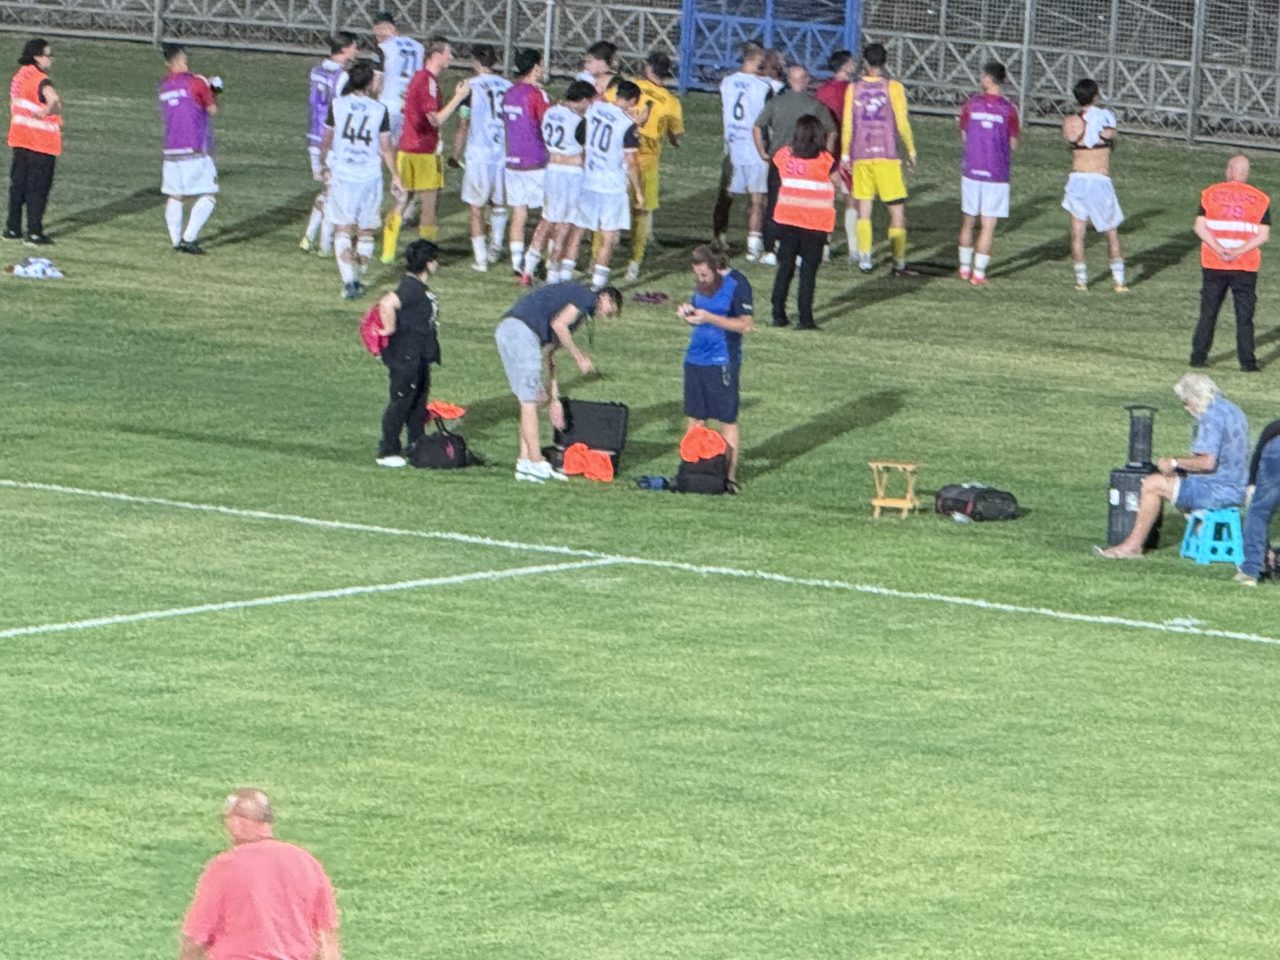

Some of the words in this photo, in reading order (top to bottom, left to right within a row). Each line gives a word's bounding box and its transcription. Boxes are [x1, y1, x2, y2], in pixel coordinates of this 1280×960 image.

[732, 91, 745, 121] 6
[343, 112, 373, 147] 44
[591, 115, 613, 152] 70
